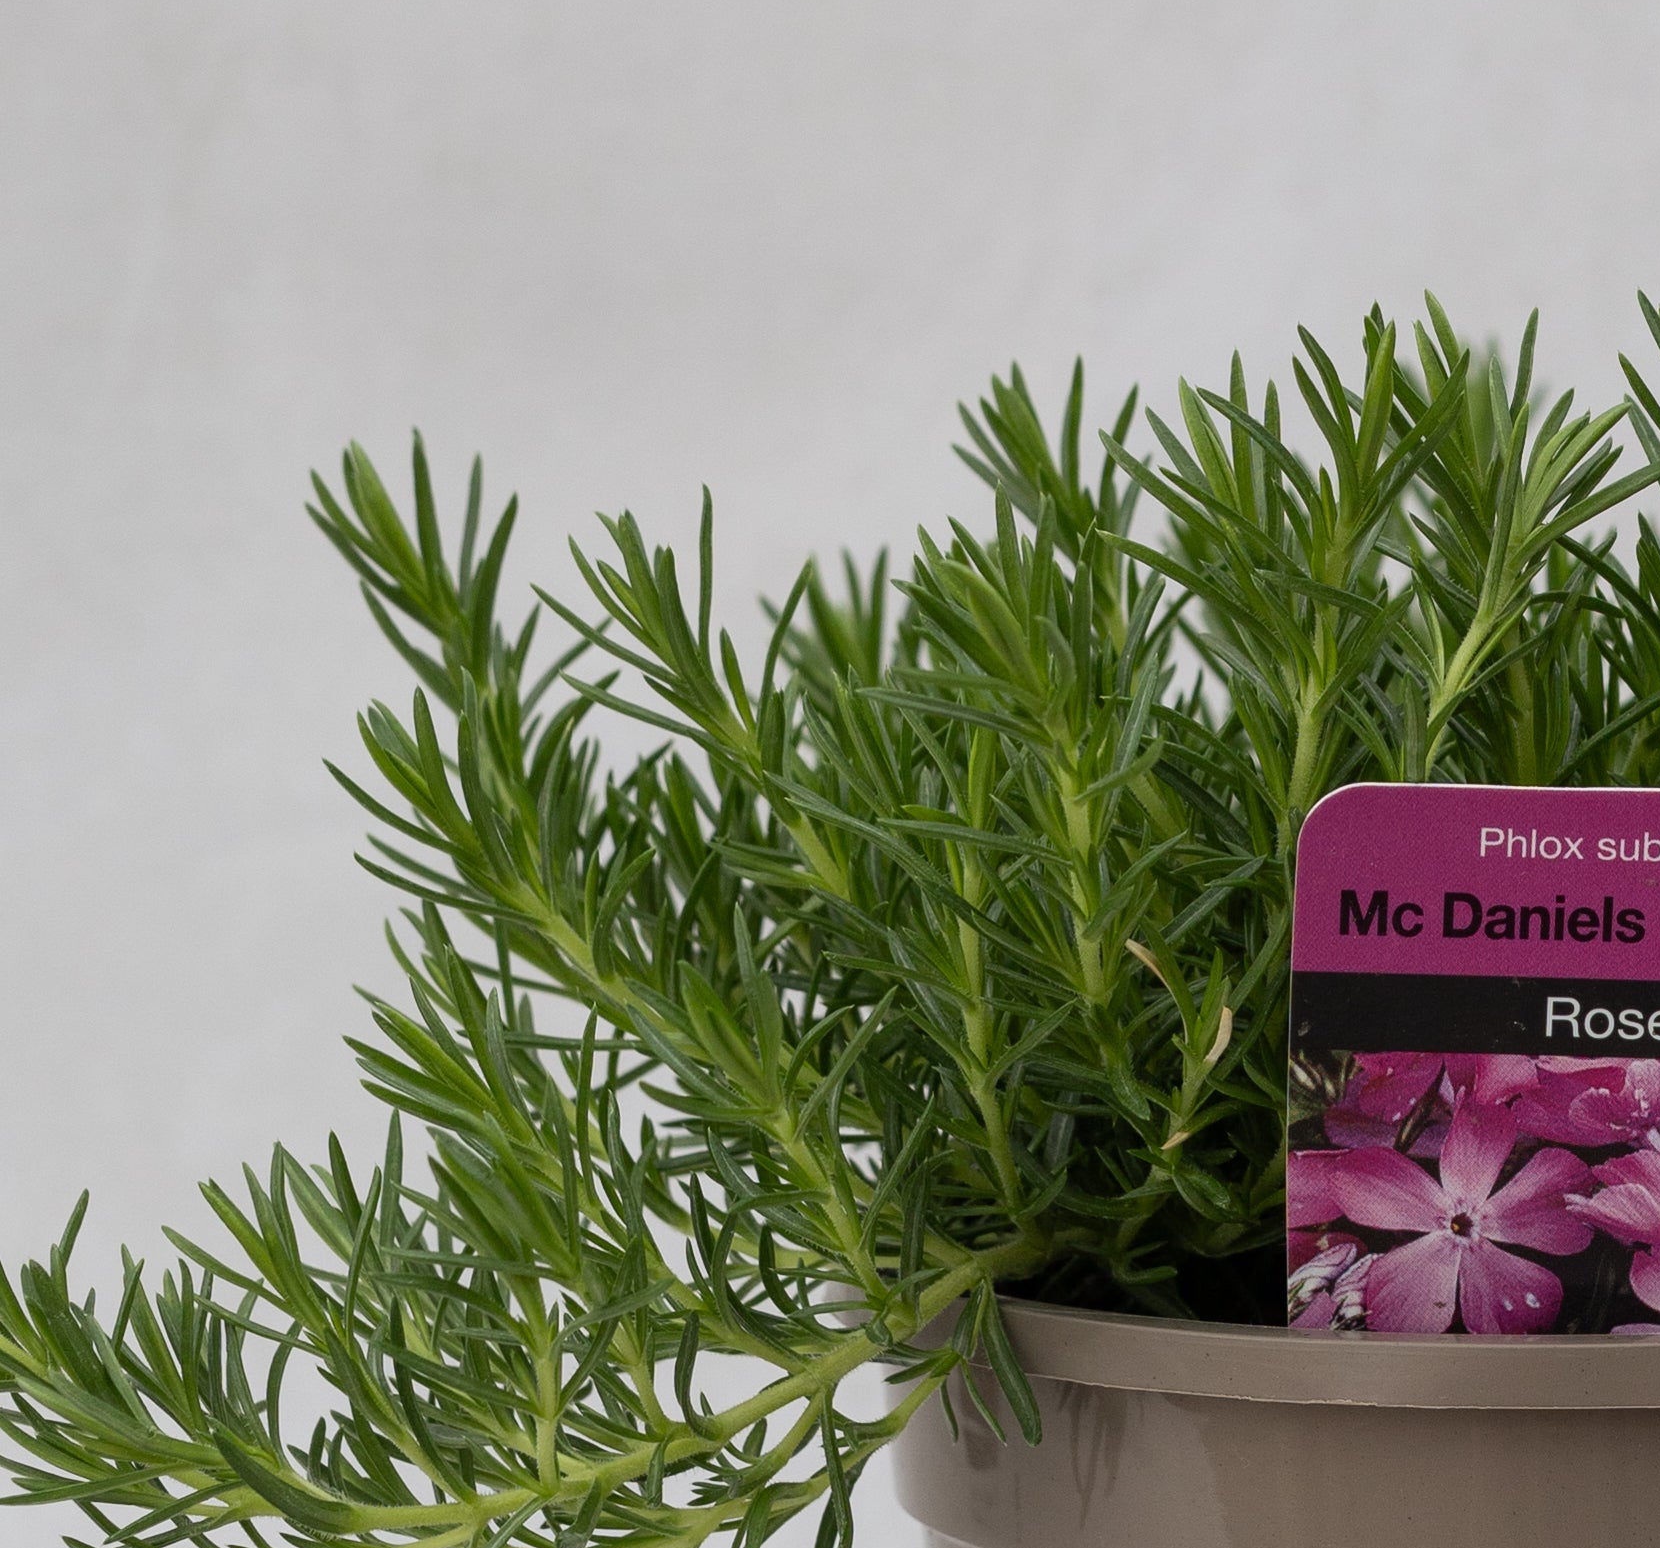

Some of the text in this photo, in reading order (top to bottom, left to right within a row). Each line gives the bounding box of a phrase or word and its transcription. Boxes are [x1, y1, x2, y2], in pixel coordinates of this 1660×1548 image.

[1478, 826, 1584, 861] Phlox
[1338, 889, 1425, 938] Mc
[1441, 892, 1647, 944] Daniels
